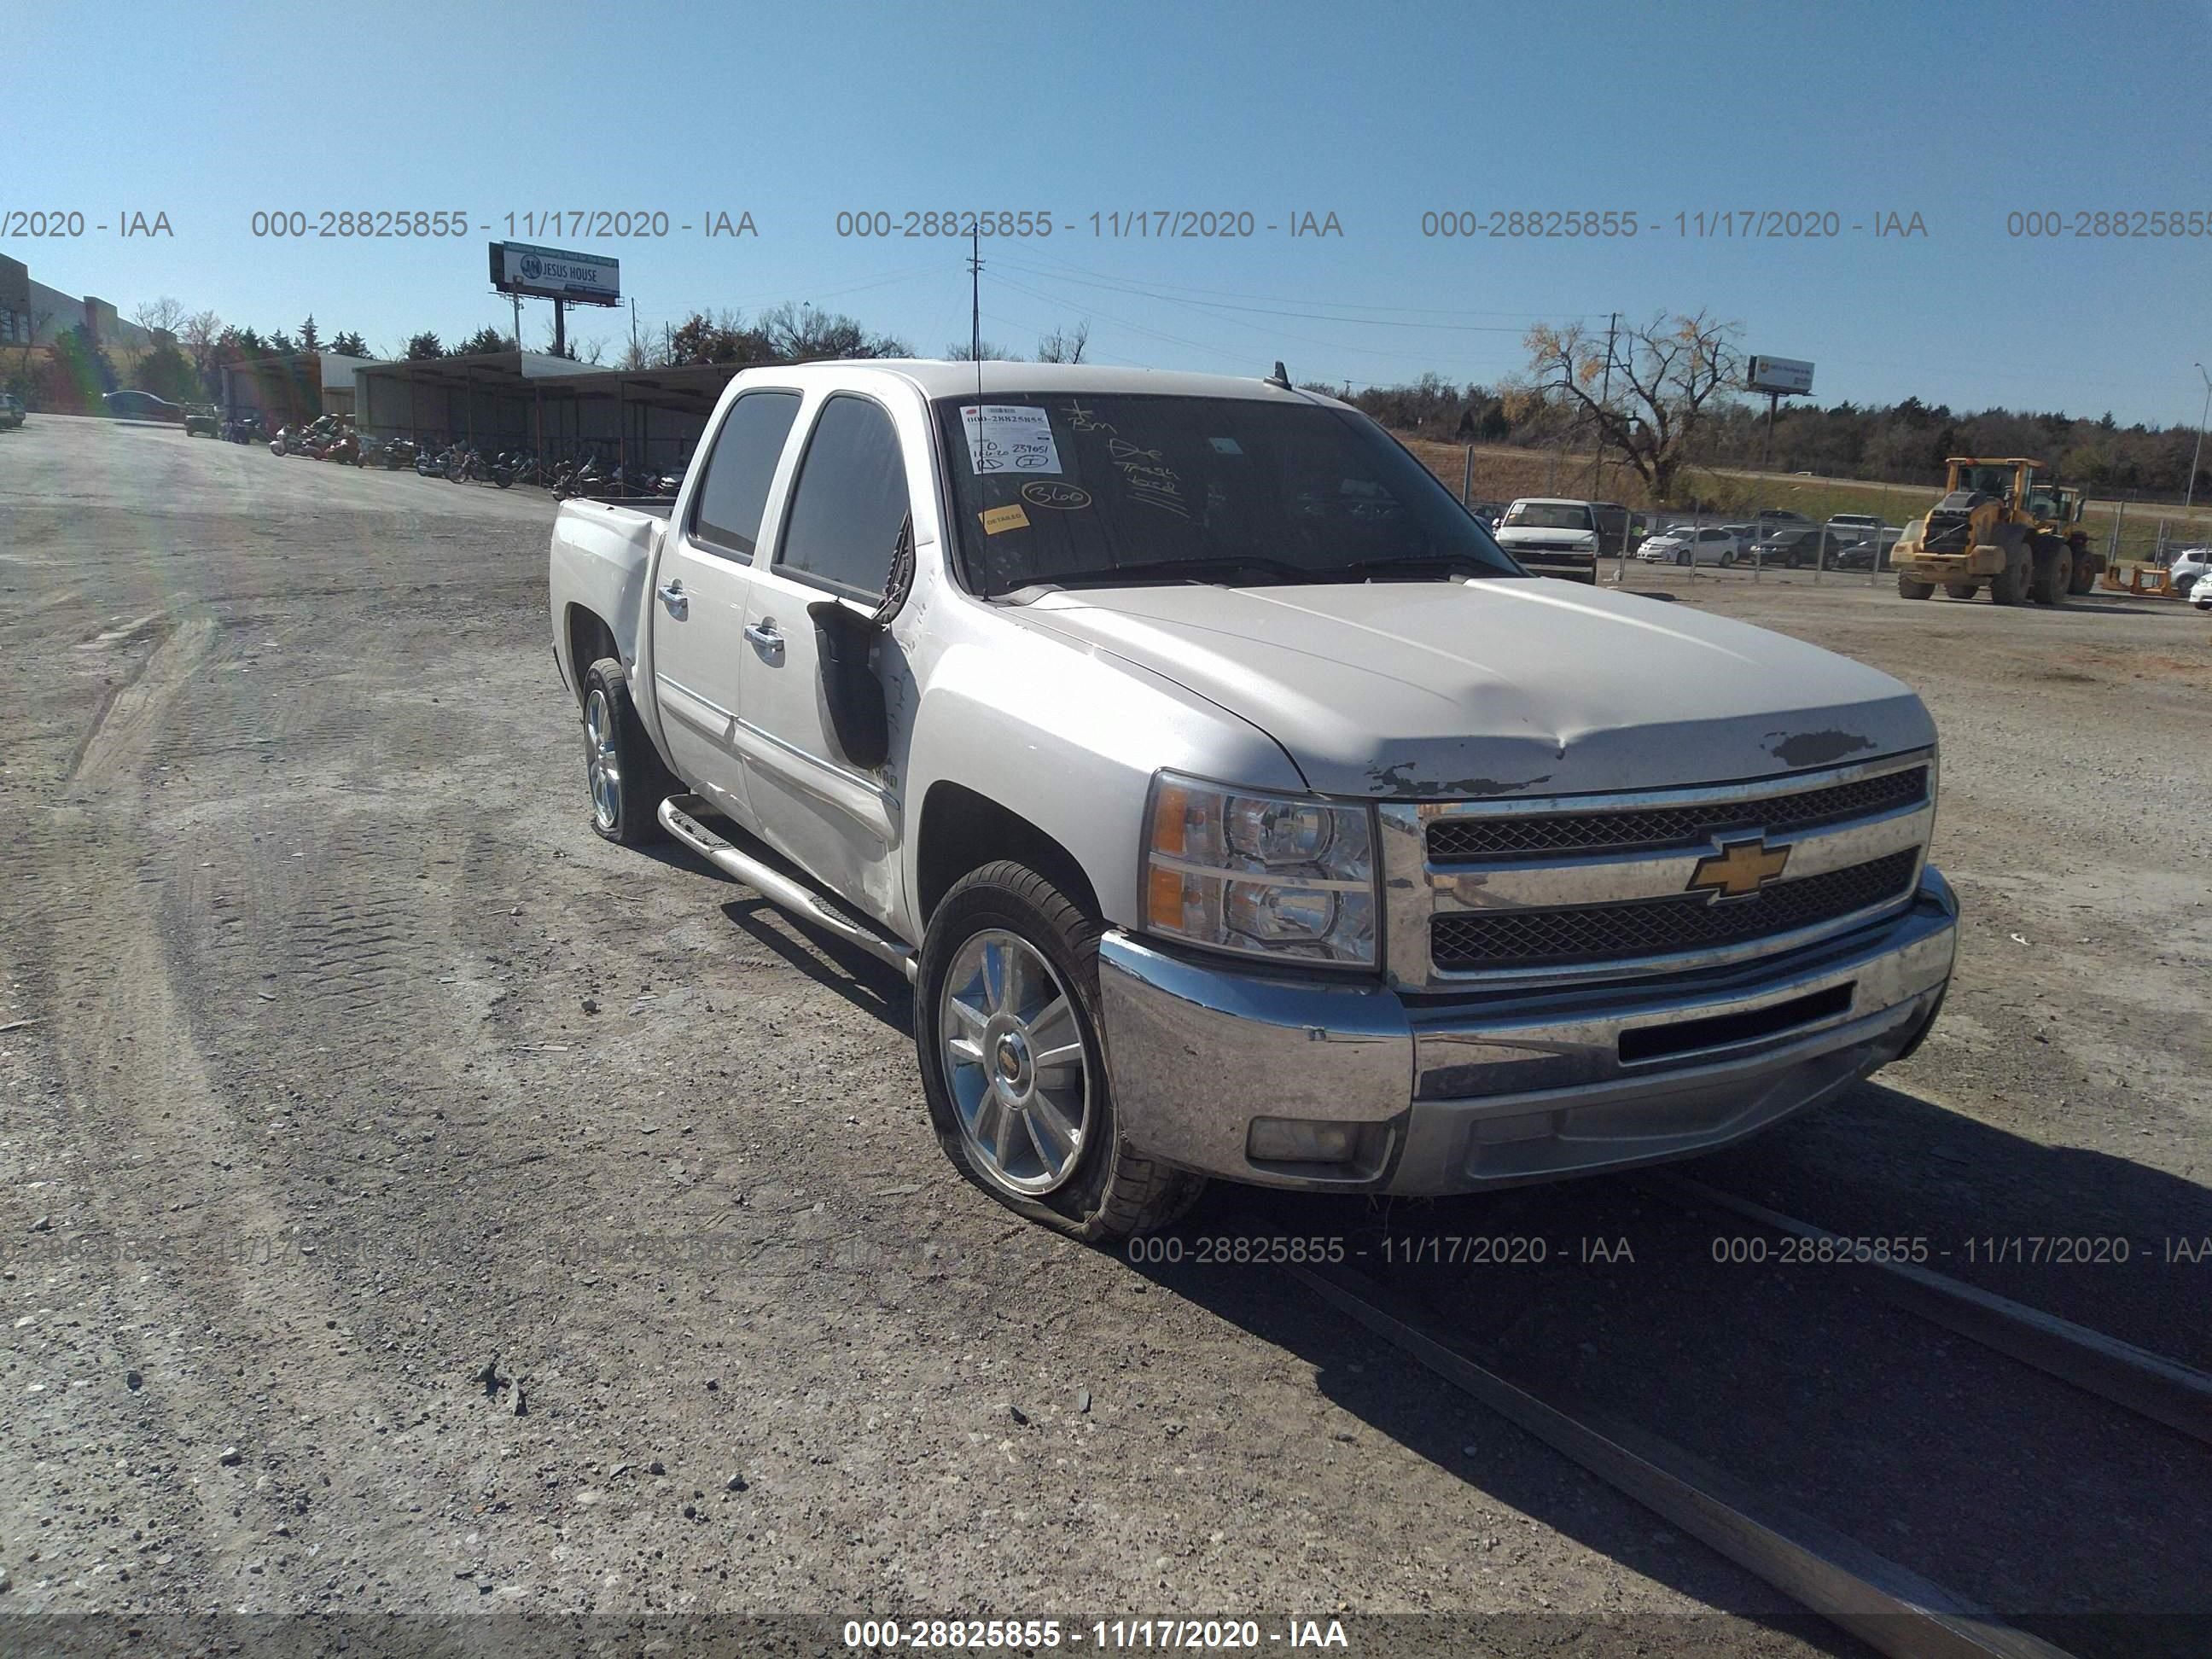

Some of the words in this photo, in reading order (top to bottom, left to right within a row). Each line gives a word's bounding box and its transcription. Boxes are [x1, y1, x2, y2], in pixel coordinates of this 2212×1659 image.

[543, 263, 568, 278] JESUS
[570, 266, 597, 282] HOUSE
[1029, 487, 1084, 504] 360
[987, 513, 1022, 526] DETAILED
